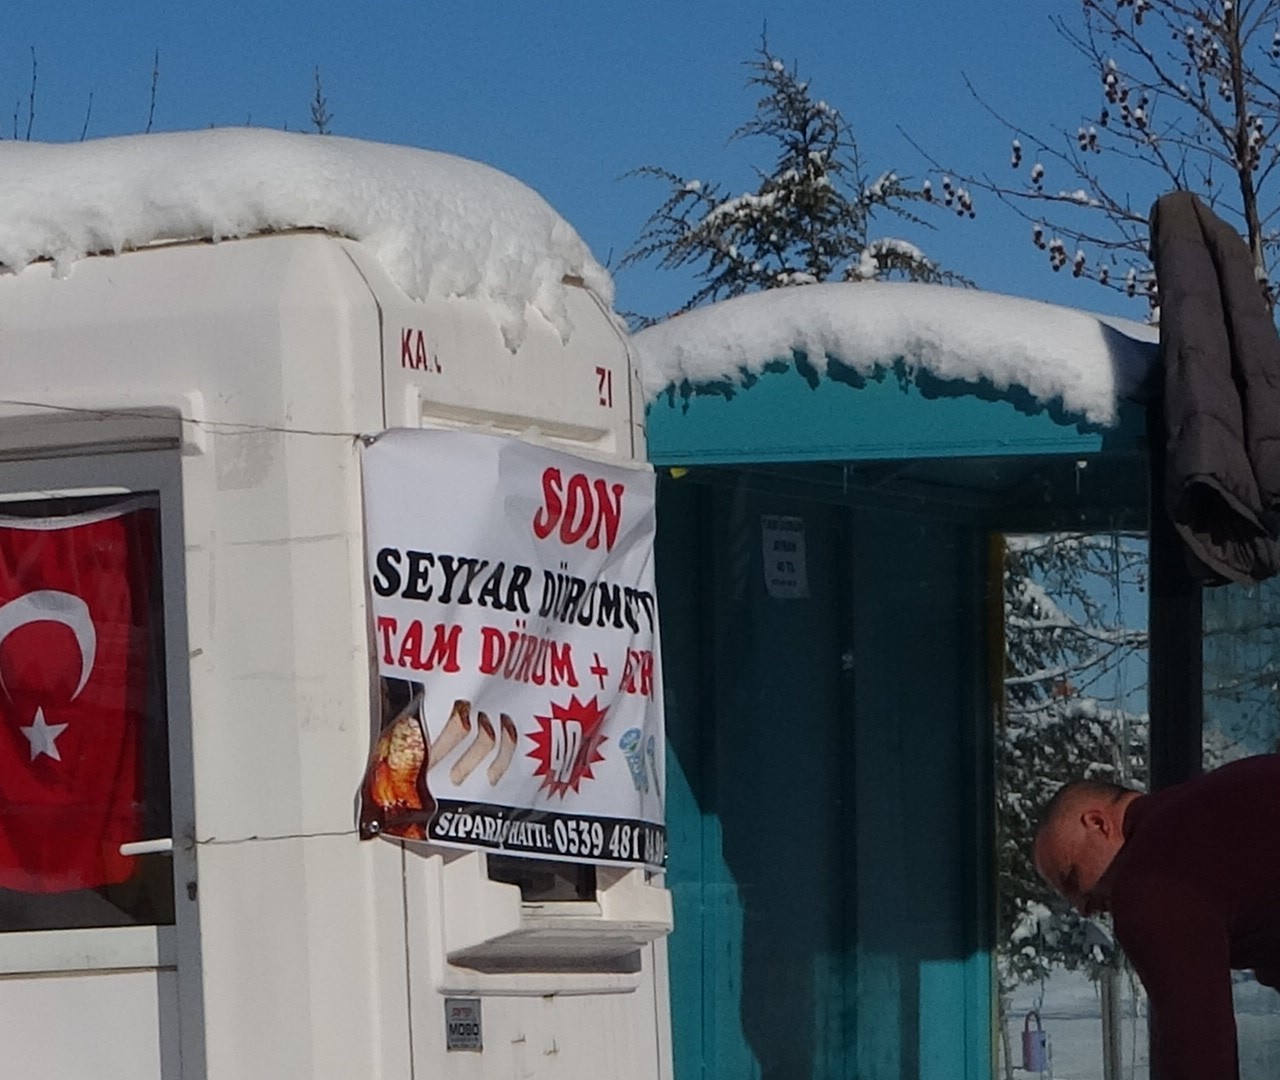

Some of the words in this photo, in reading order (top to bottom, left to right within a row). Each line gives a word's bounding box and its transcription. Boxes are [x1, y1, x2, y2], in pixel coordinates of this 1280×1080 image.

[534, 467, 624, 553] SON
[373, 548, 531, 613] SEYYAR
[377, 616, 462, 673] TAM
[479, 619, 579, 688] DÜRÜM
[554, 818, 604, 857] 0539
[609, 824, 640, 860] 481
